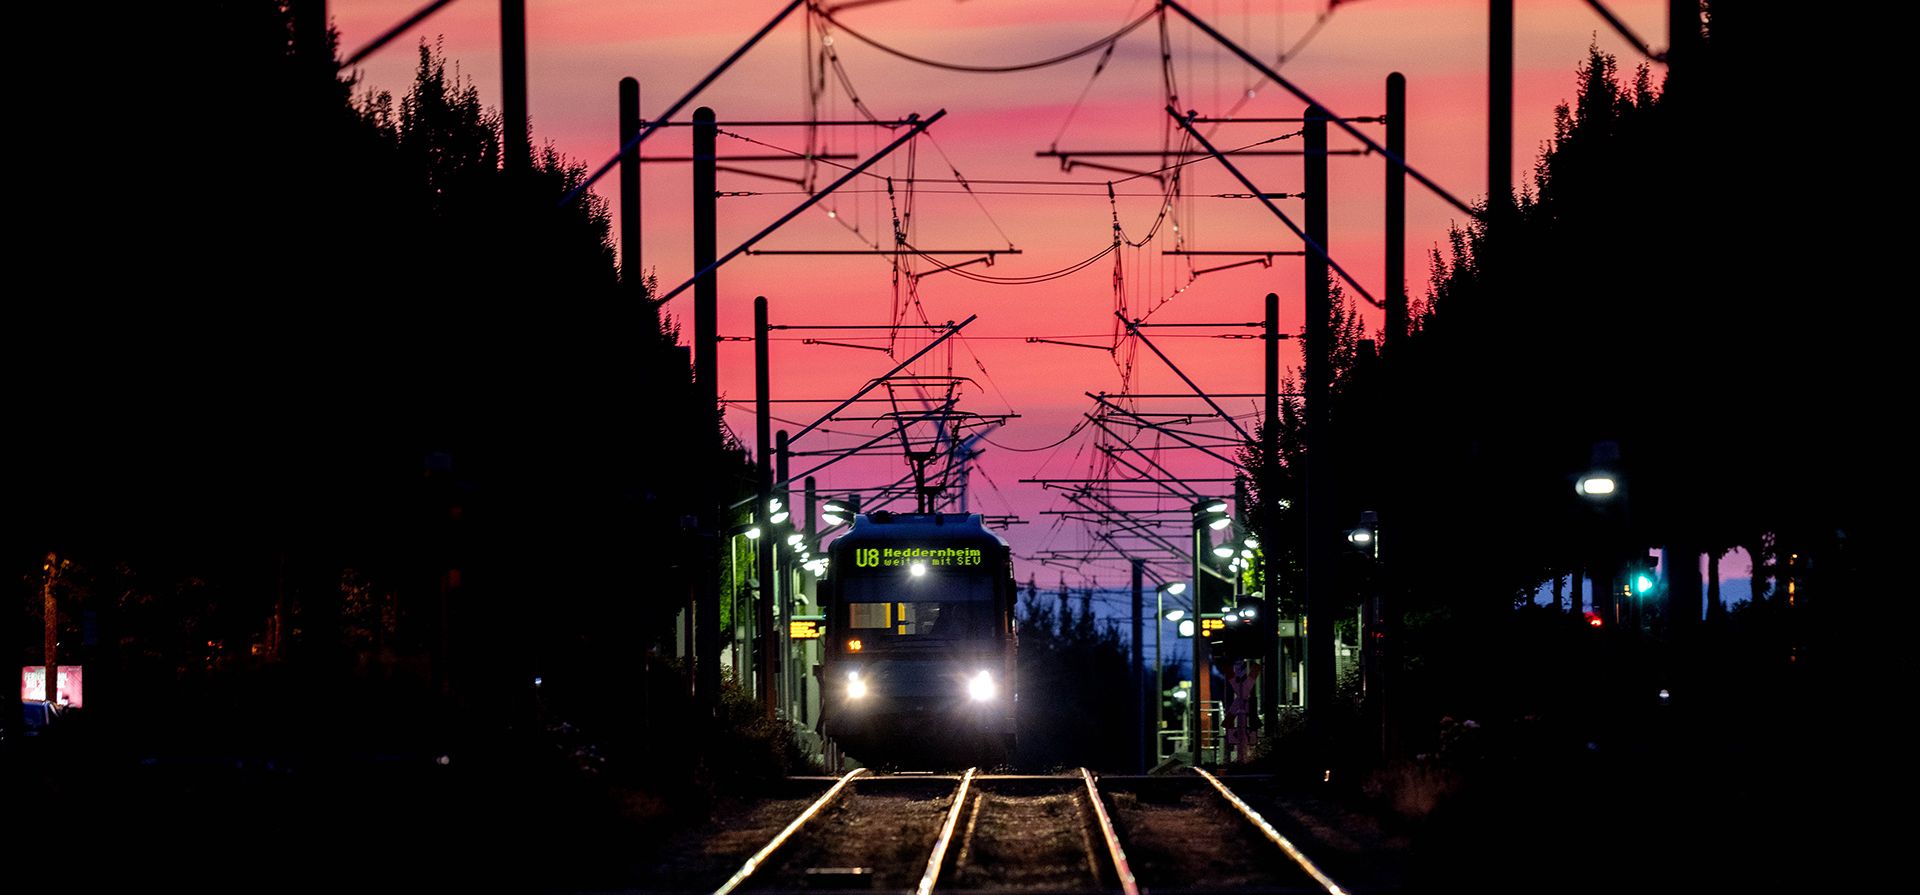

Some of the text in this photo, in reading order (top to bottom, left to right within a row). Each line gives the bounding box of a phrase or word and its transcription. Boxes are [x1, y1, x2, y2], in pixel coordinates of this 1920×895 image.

[883, 547, 981, 557] Heddernheim
[856, 548, 879, 567] U8
[932, 556, 951, 566] mit
[957, 556, 981, 566] SEV
